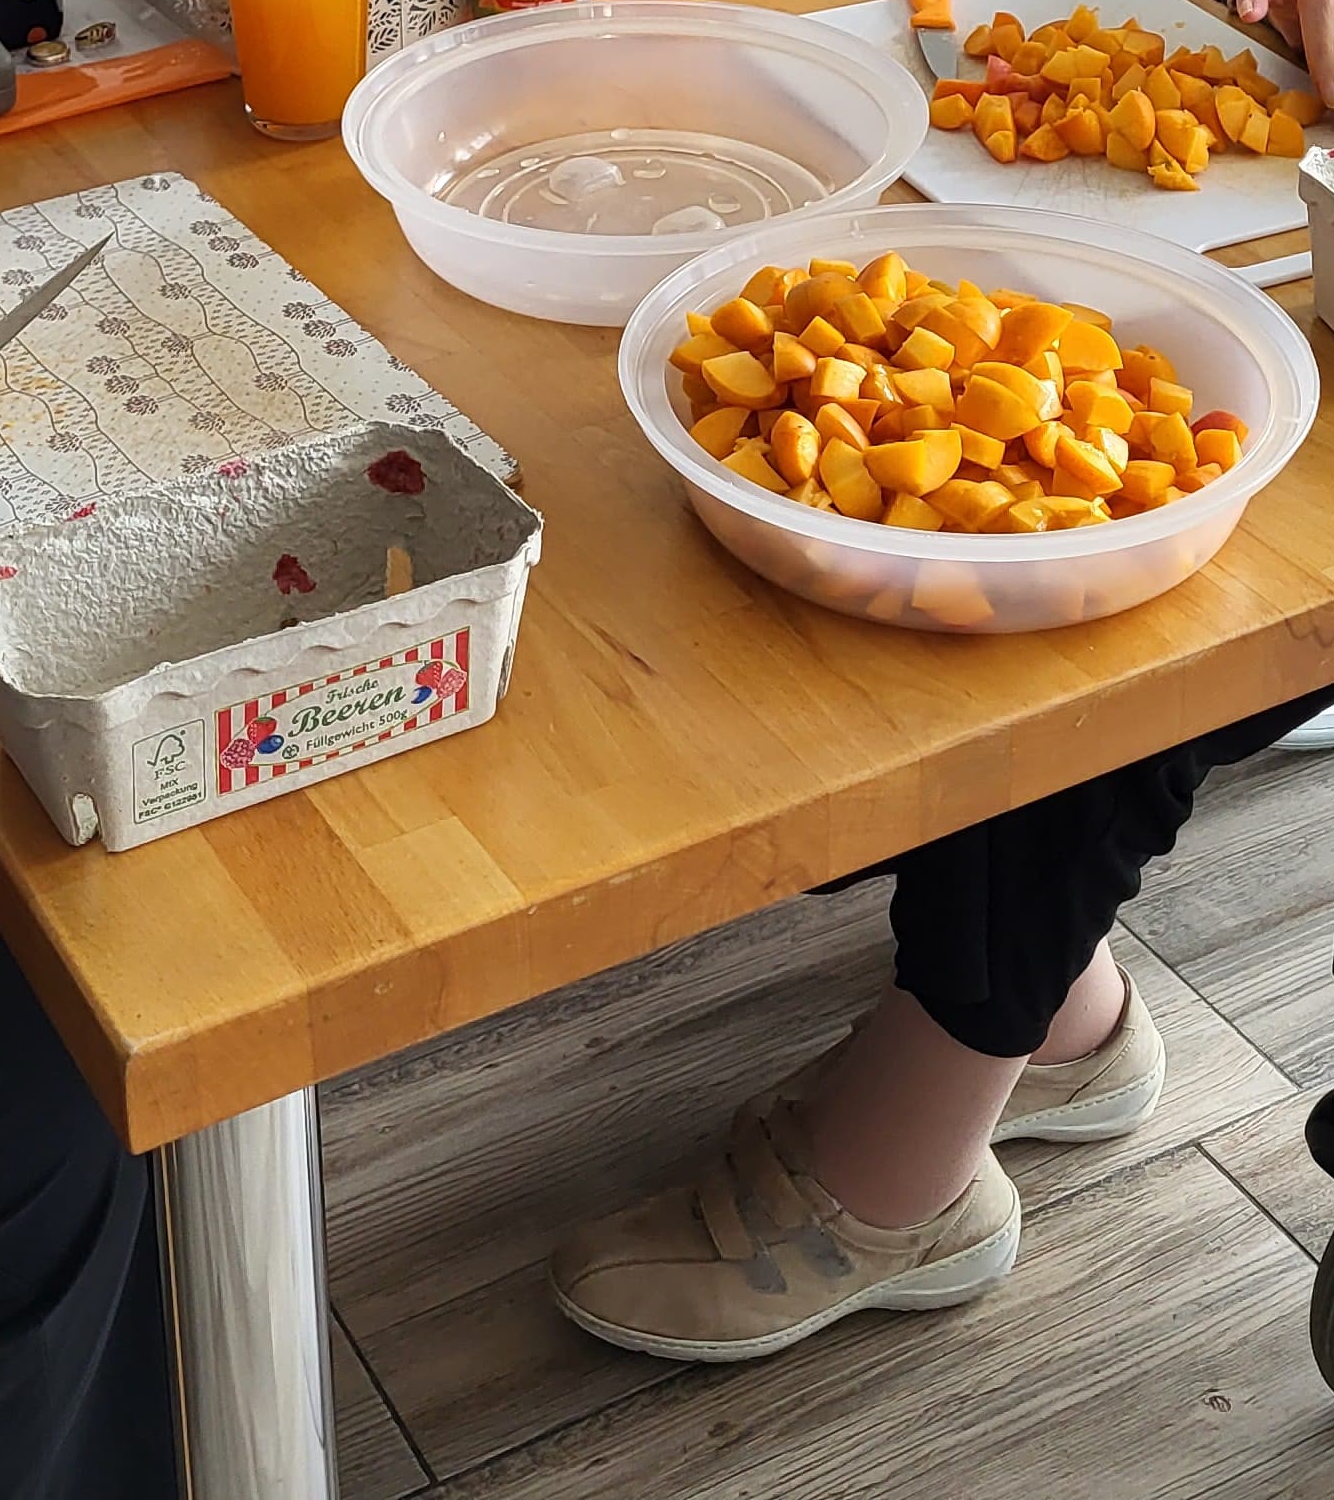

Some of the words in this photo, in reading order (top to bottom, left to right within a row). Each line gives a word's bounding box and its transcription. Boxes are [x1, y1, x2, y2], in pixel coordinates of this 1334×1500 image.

[325, 678, 379, 704] Frische
[287, 686, 407, 738] Beeren
[306, 721, 376, 751] Füllgewicht
[378, 708, 408, 727] 500g
[154, 760, 187, 780] FSC
